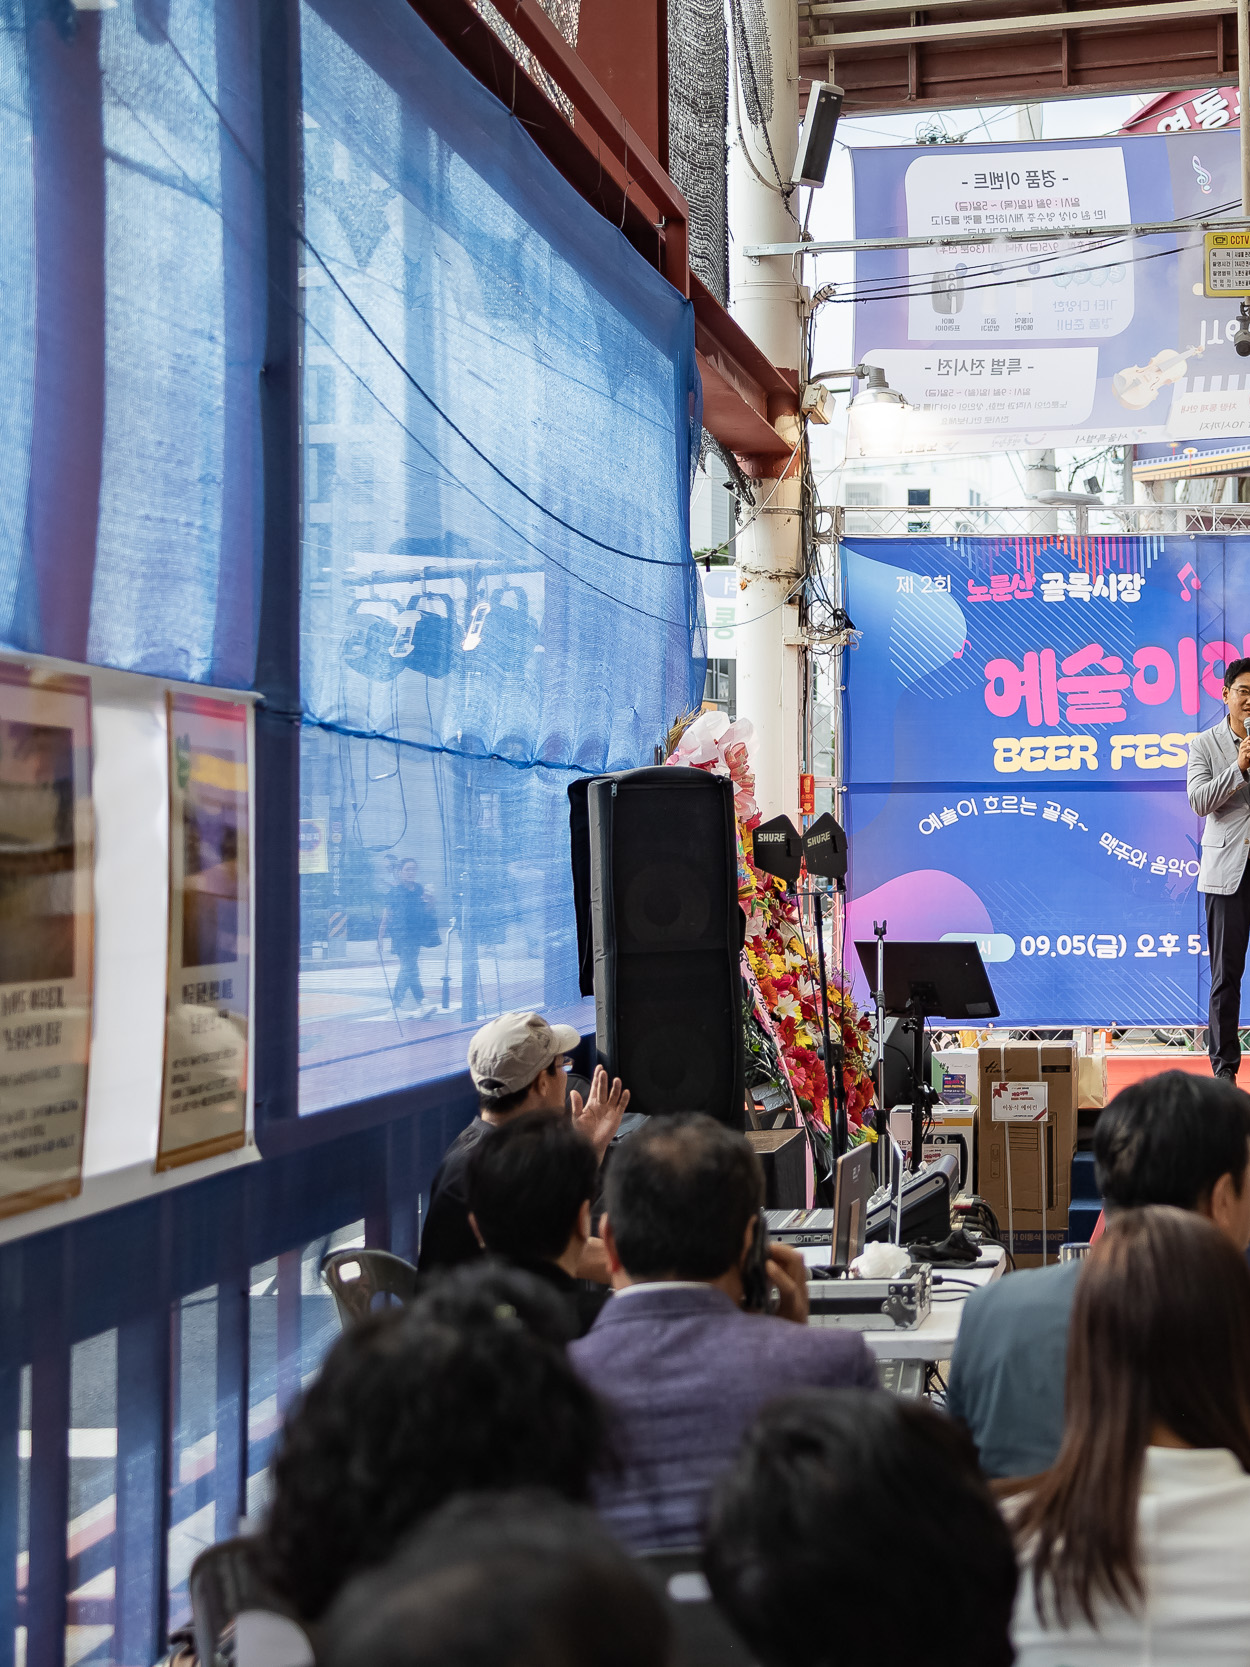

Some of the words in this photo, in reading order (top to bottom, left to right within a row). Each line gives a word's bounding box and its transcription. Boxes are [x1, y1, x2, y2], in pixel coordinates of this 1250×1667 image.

[1230, 235, 1250, 244] CCTV
[896, 575, 914, 594] 제
[920, 575, 952, 593] 2회
[967, 572, 1036, 603] 노룬산
[1040, 572, 1146, 603] 골목시장
[992, 734, 1099, 773] BEER
[757, 832, 786, 842] SHURE
[806, 831, 831, 848] SHURE
[918, 797, 979, 835] 예술이
[983, 795, 1038, 817] 흐르는
[1098, 832, 1147, 870] 맥주와
[1020, 933, 1128, 960] 09.05(금)
[1134, 933, 1181, 958] 오후
